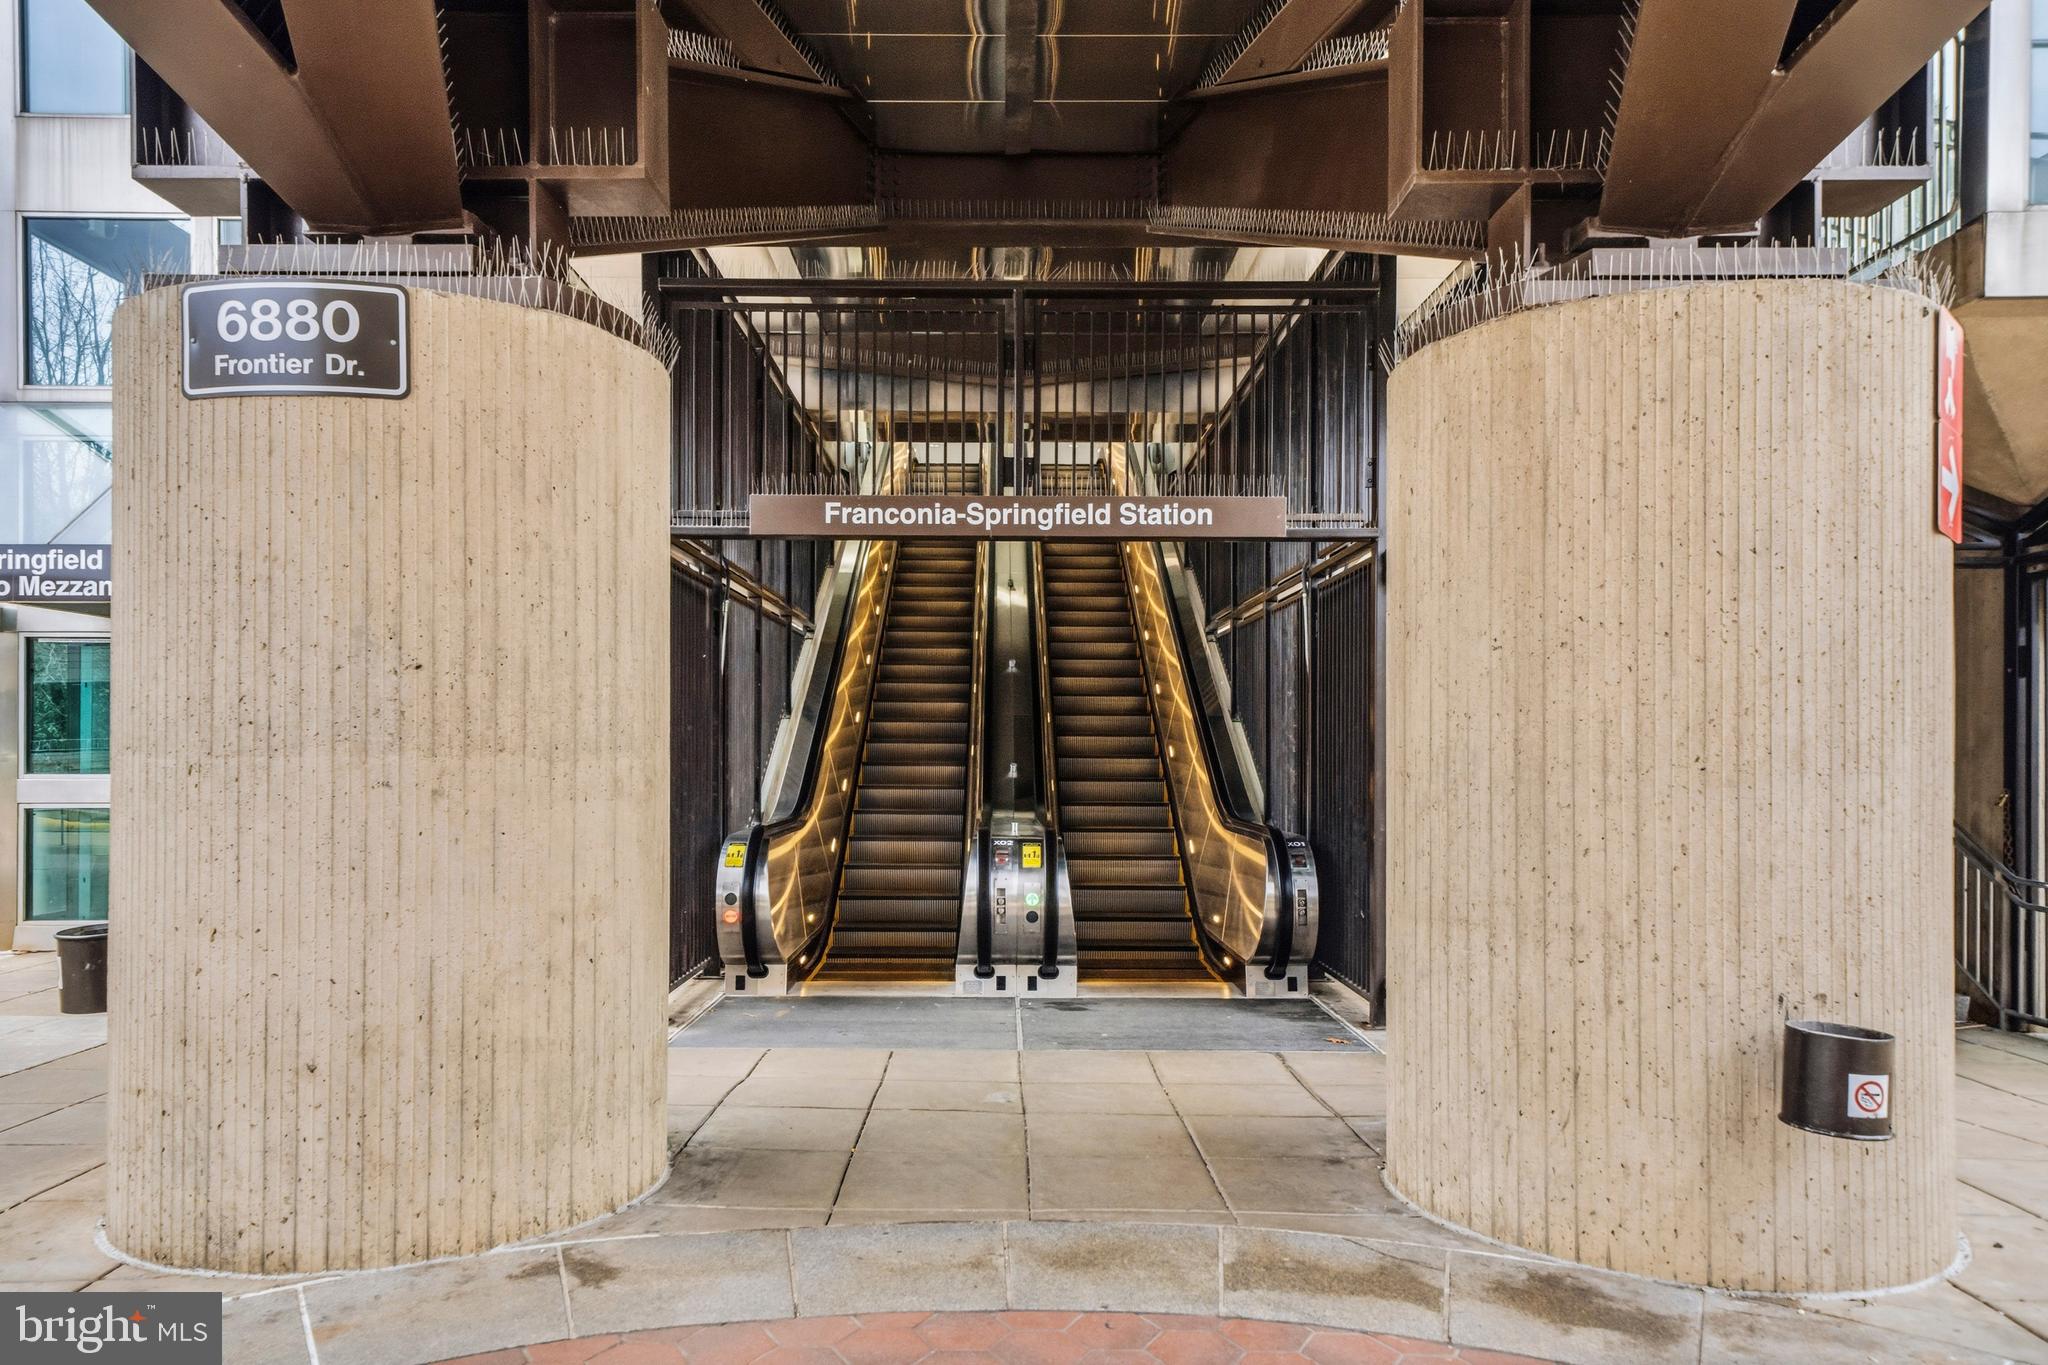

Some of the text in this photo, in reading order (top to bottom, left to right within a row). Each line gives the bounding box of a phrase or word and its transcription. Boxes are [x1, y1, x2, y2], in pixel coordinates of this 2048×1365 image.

[217, 299, 360, 343] 6880
[214, 352, 365, 376] Frontier Dr.
[825, 502, 1213, 531] Franconia-Springfield Station
[18, 575, 112, 597] Mezzan
